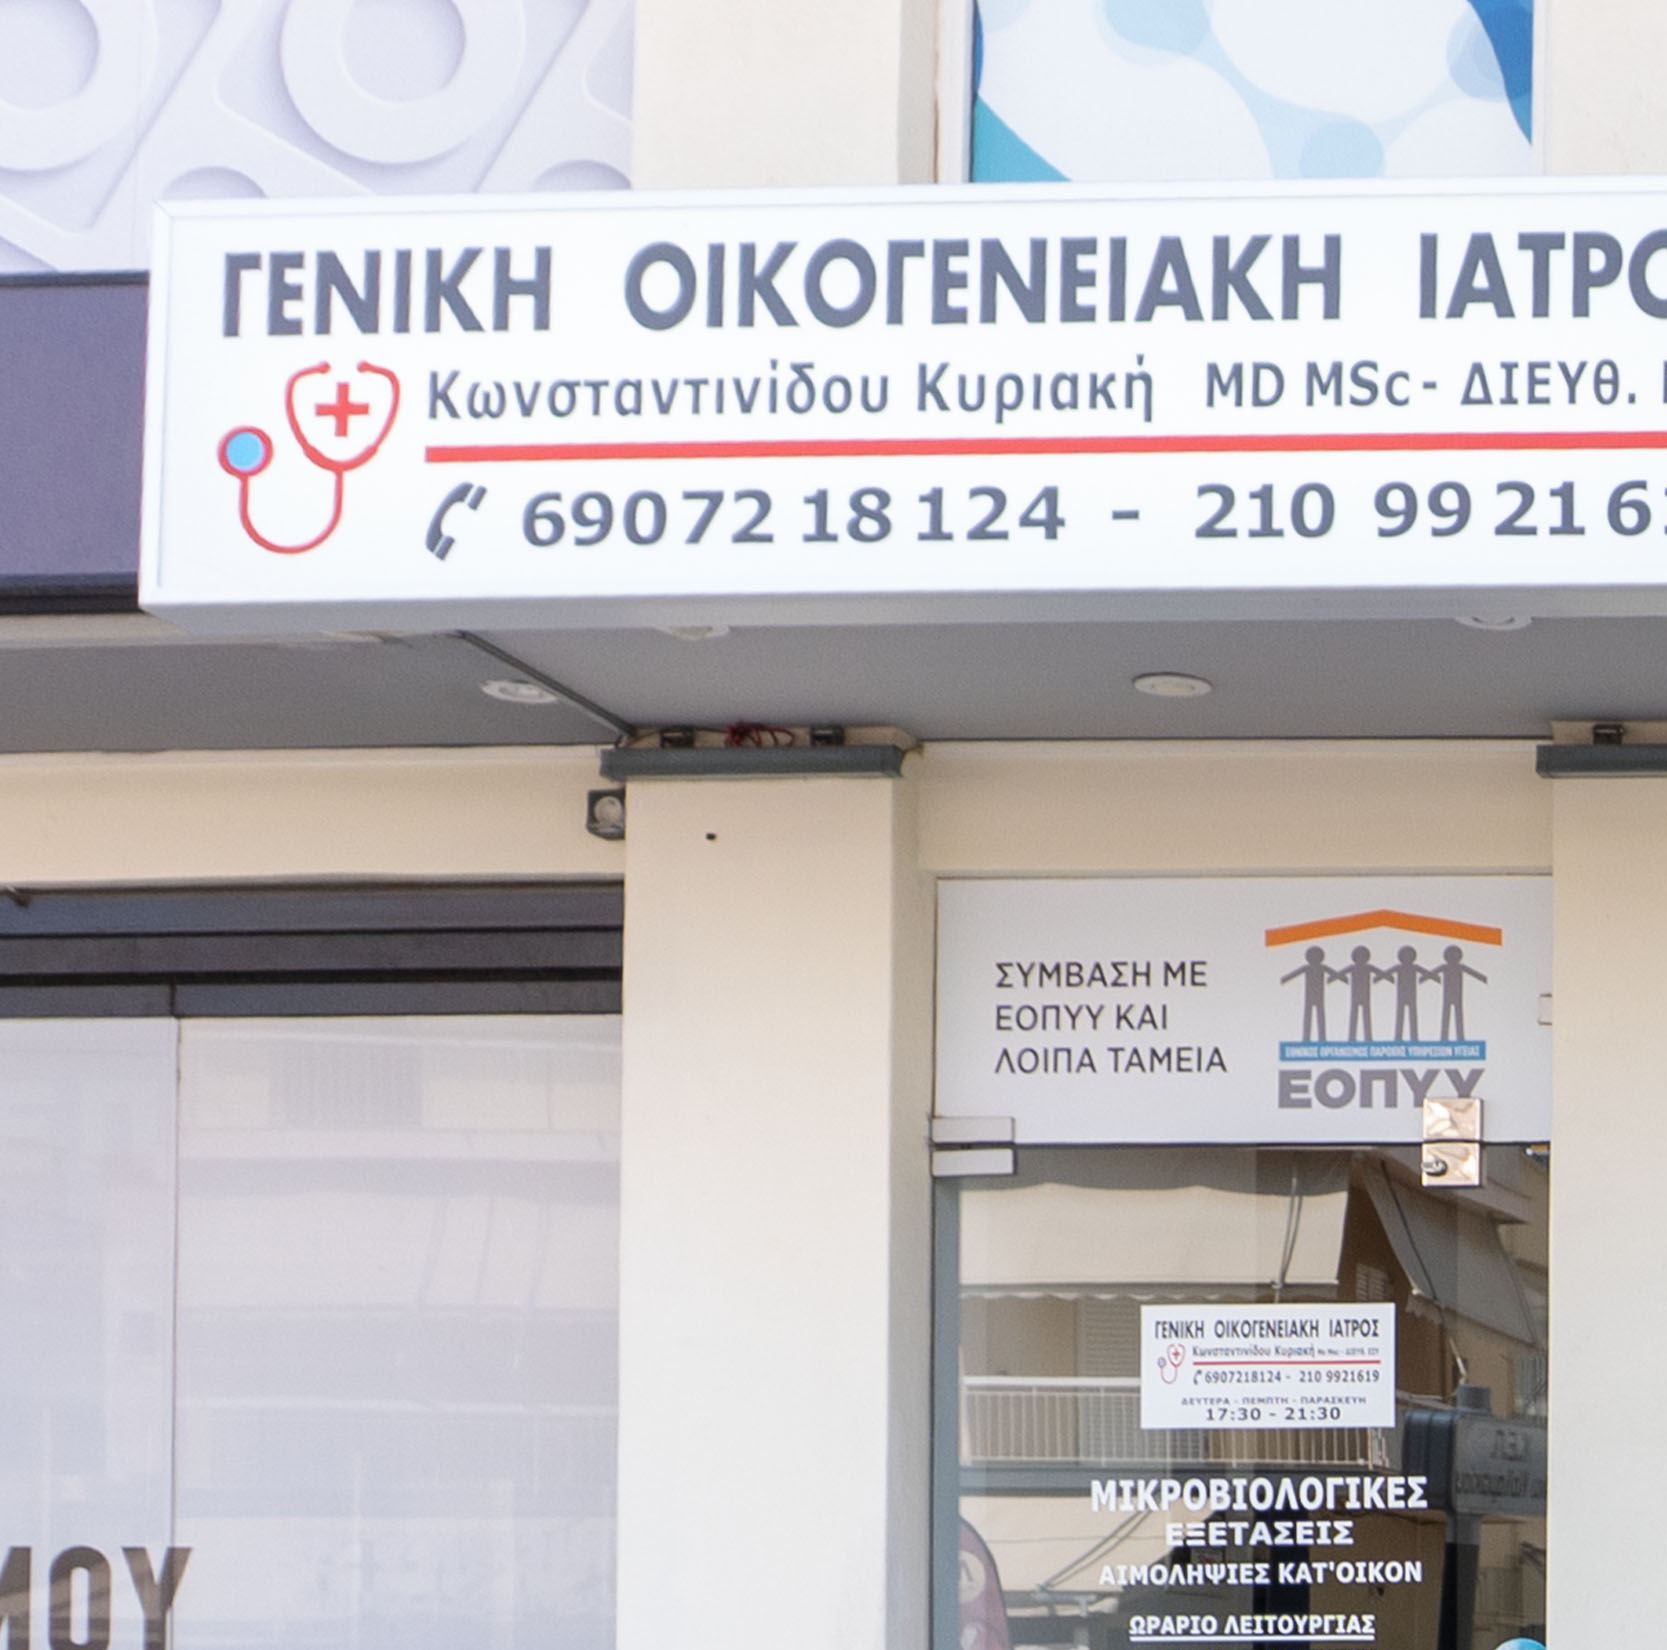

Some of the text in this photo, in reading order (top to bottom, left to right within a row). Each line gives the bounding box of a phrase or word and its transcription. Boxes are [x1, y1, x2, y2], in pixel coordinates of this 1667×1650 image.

[222, 245, 552, 338] ΓΕΝΙΚΗ
[624, 234, 1342, 332] ΟΙΚΟΓΕΝΕΙΑΚΗ
[428, 358, 890, 419] Κωνσταντινίδου
[917, 354, 1154, 424] Κυριακή
[1206, 361, 1285, 408] MD
[1195, 482, 1336, 538] 210
[994, 959, 1208, 988] ΣΥΜΒΑΣΗ ΜΕ
[994, 1003, 1169, 1032] ΕΟΠΥΥ ΚΑΙ
[994, 1046, 1228, 1074] ΛΟΙΠΑ ΤΑΜΕΙΑ
[1278, 1068, 1486, 1109] ΕΟΠΥΥ
[1154, 1318, 1380, 1339] ΓΕΝΙΚΗ ΟΙΚΟΓΕΝΕΙΑΚΗ ΙΑΤΡΟΣ
[1204, 1370, 1282, 1384] 6907218124
[1299, 1369, 1322, 1383] 210
[1326, 1368, 1380, 1383] 9921619
[1205, 1407, 1262, 1421] 17:30
[1284, 1406, 1342, 1421] 21:30
[1090, 1476, 1428, 1513] ΜΙΚΡΟΒΙΟΛΟΓΙΚΕΣ
[1165, 1520, 1355, 1547] ΕΞΕΤΑΣΕΙΣ
[1099, 1562, 1272, 1586] ΑΙΜΟΛΗΨΙΕΣ
[1129, 1615, 1376, 1636] ΩΡΑΡΙΟ ΛΕΙΤΟΥΡΓΙΑΣ
